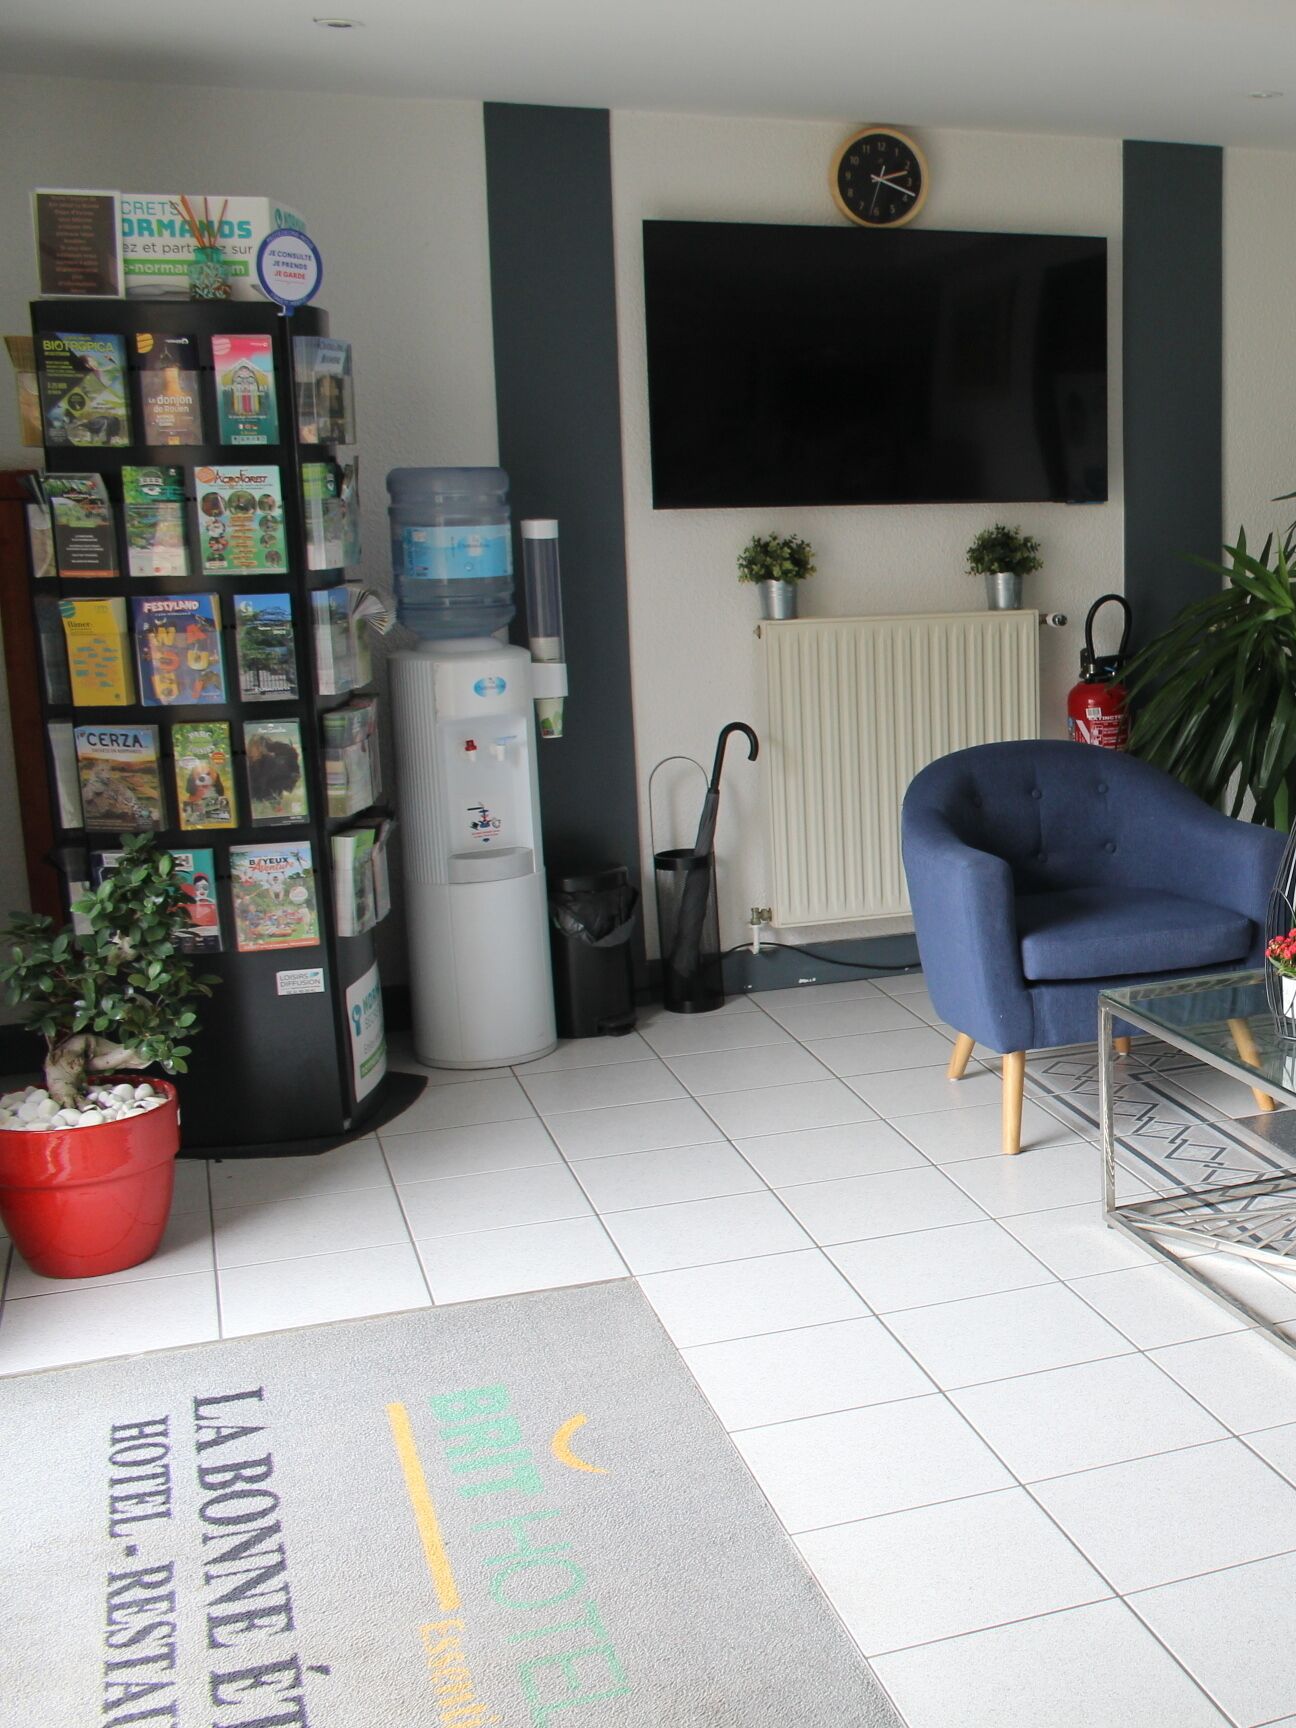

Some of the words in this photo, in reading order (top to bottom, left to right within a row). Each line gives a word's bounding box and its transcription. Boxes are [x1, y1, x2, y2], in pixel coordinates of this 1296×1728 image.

[142, 242, 157, 254] et
[231, 244, 253, 255] sur
[276, 250, 312, 261] CONSULTE
[281, 261, 308, 270] PRENDS
[282, 271, 306, 280] GARDE
[42, 340, 114, 352] BIOTROPICA
[143, 600, 200, 613] FESTYLAND
[86, 732, 144, 748] CERZA
[280, 979, 321, 988] DIFFUSION
[193, 1385, 265, 1455] LA
[428, 1382, 545, 1499] BRIT
[108, 1414, 172, 1543] HOTEL
[196, 1452, 296, 1650] BONNE
[471, 1507, 633, 1728] HOTEL
